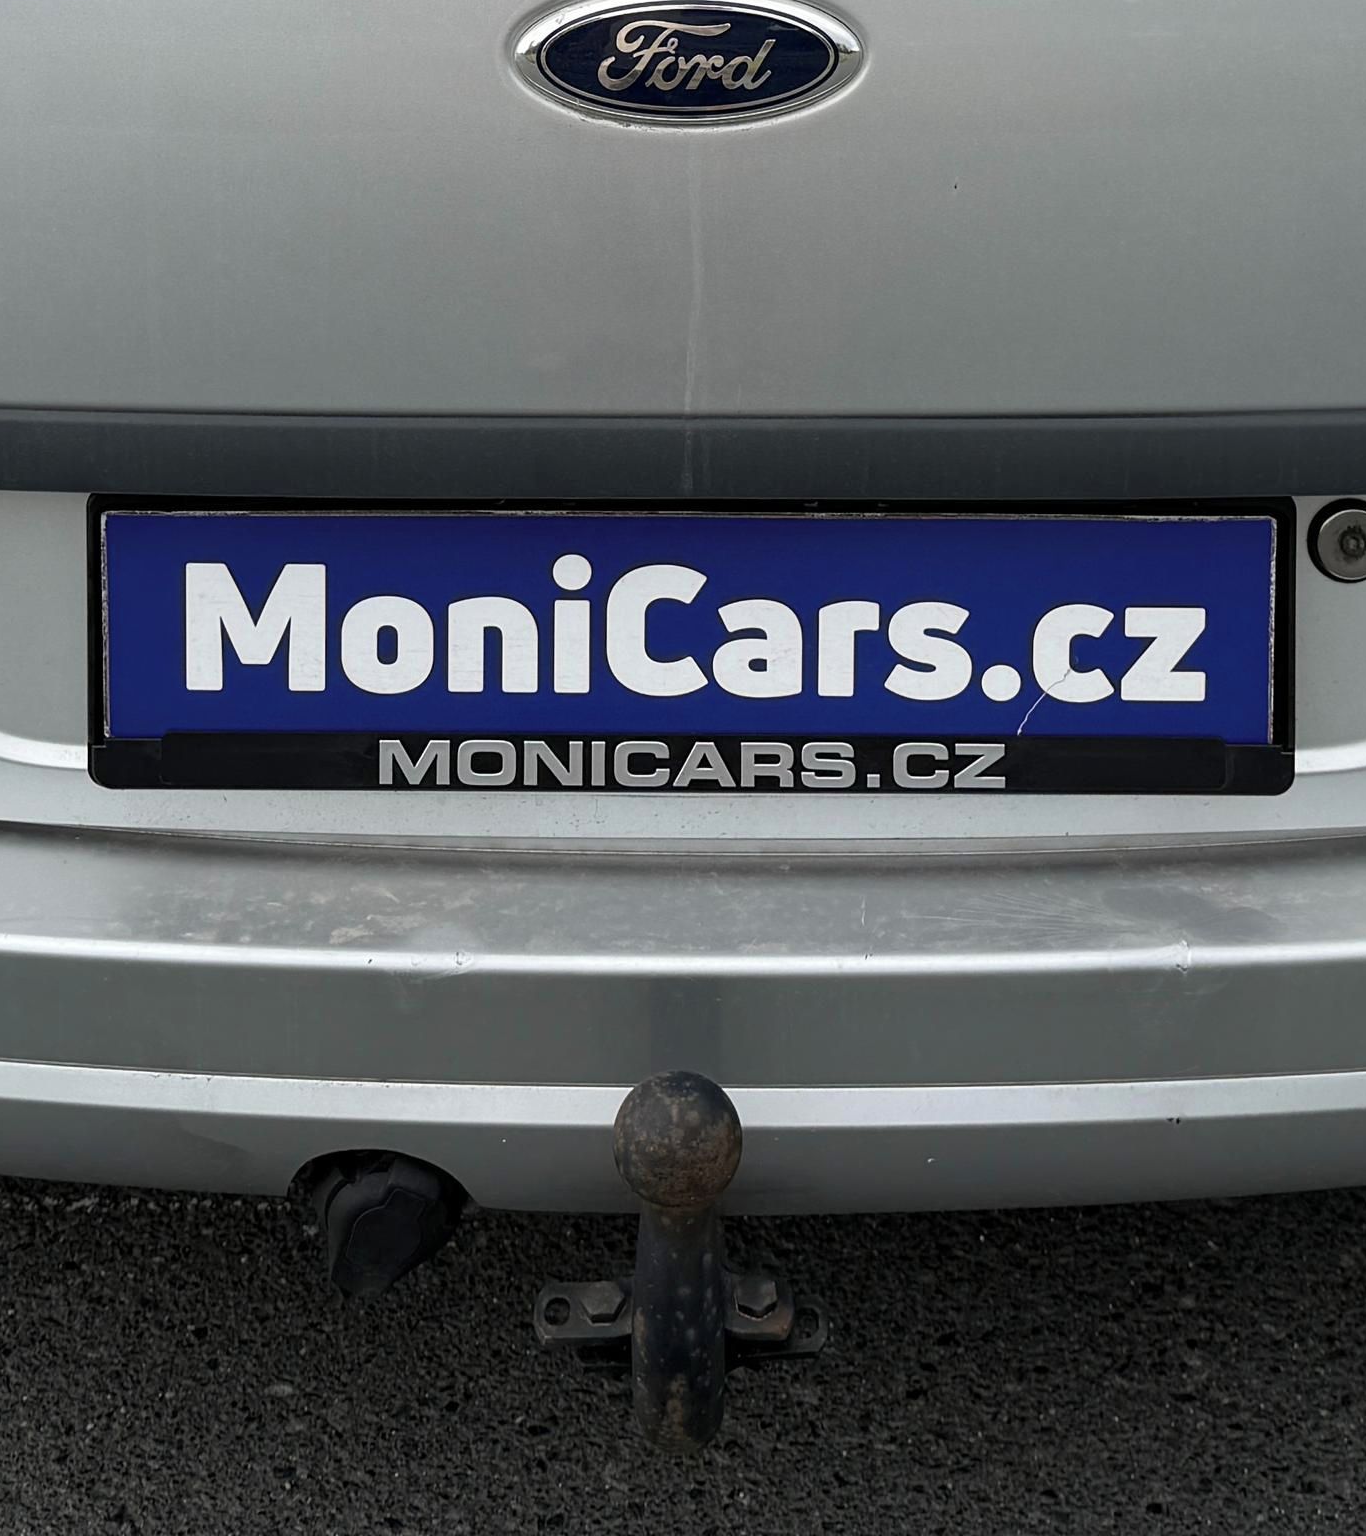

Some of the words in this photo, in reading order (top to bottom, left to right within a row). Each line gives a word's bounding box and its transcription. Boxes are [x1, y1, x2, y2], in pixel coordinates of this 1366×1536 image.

[597, 20, 776, 92] Ford
[183, 554, 1206, 703] MoniCars.cz
[377, 739, 1007, 791] MONICARS.CZ
